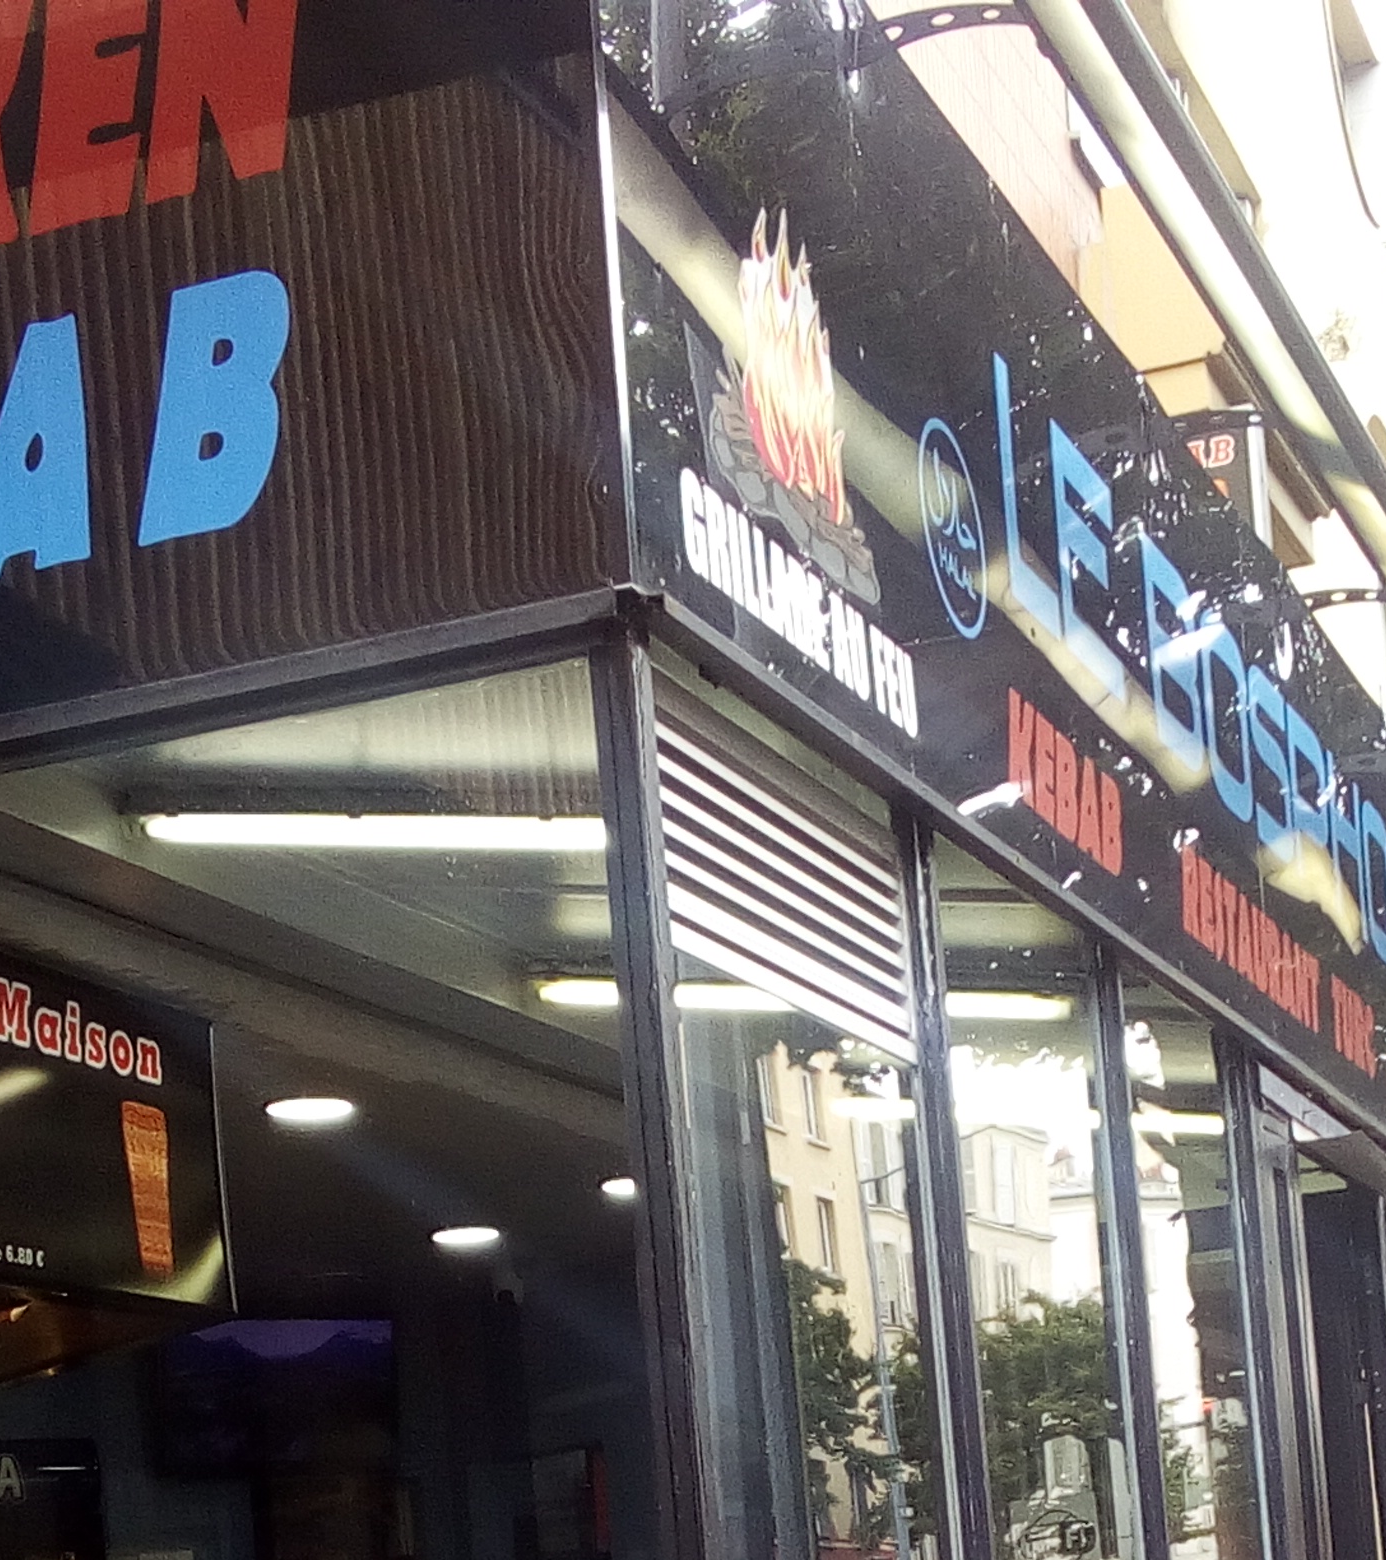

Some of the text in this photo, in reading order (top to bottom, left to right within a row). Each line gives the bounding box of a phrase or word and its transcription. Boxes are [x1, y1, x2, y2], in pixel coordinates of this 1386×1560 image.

[680, 466, 918, 738] GRILLADE AU FEU
[927, 446, 977, 551] حلال
[938, 541, 976, 601] HALAL
[991, 352, 1127, 702] LE
[1008, 686, 1124, 878] KEBAB
[1181, 843, 1320, 1035] RESTAURANT
